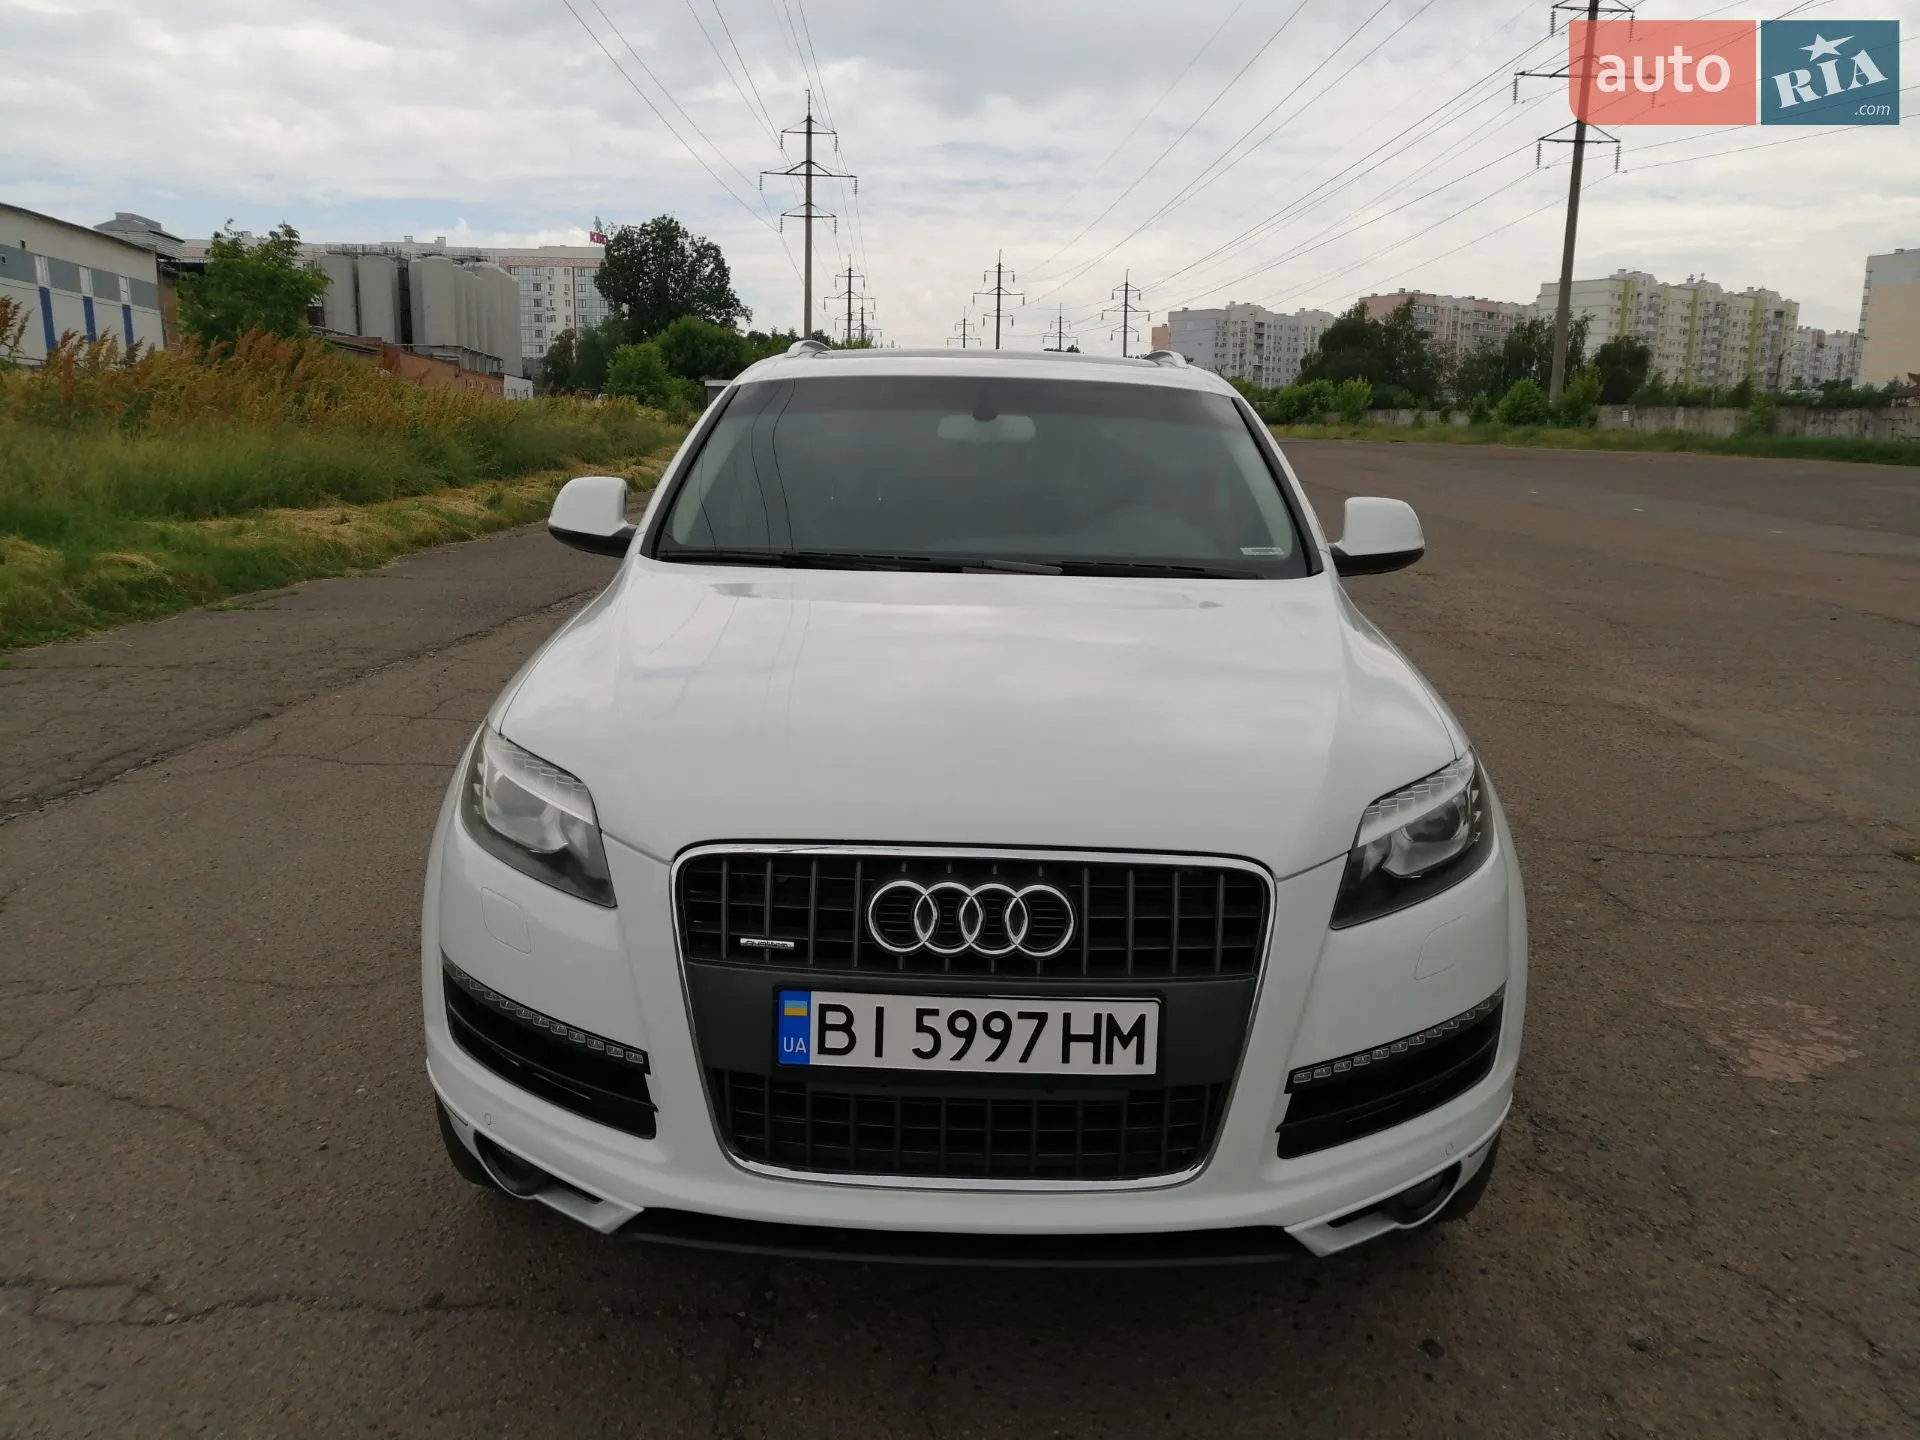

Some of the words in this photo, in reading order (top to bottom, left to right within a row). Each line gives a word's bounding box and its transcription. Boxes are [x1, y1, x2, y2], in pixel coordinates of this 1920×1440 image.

[783, 1037, 807, 1053] UA
[817, 1003, 885, 1058] BI
[911, 1007, 1049, 1064] 5997
[1061, 1012, 1147, 1066] HM
